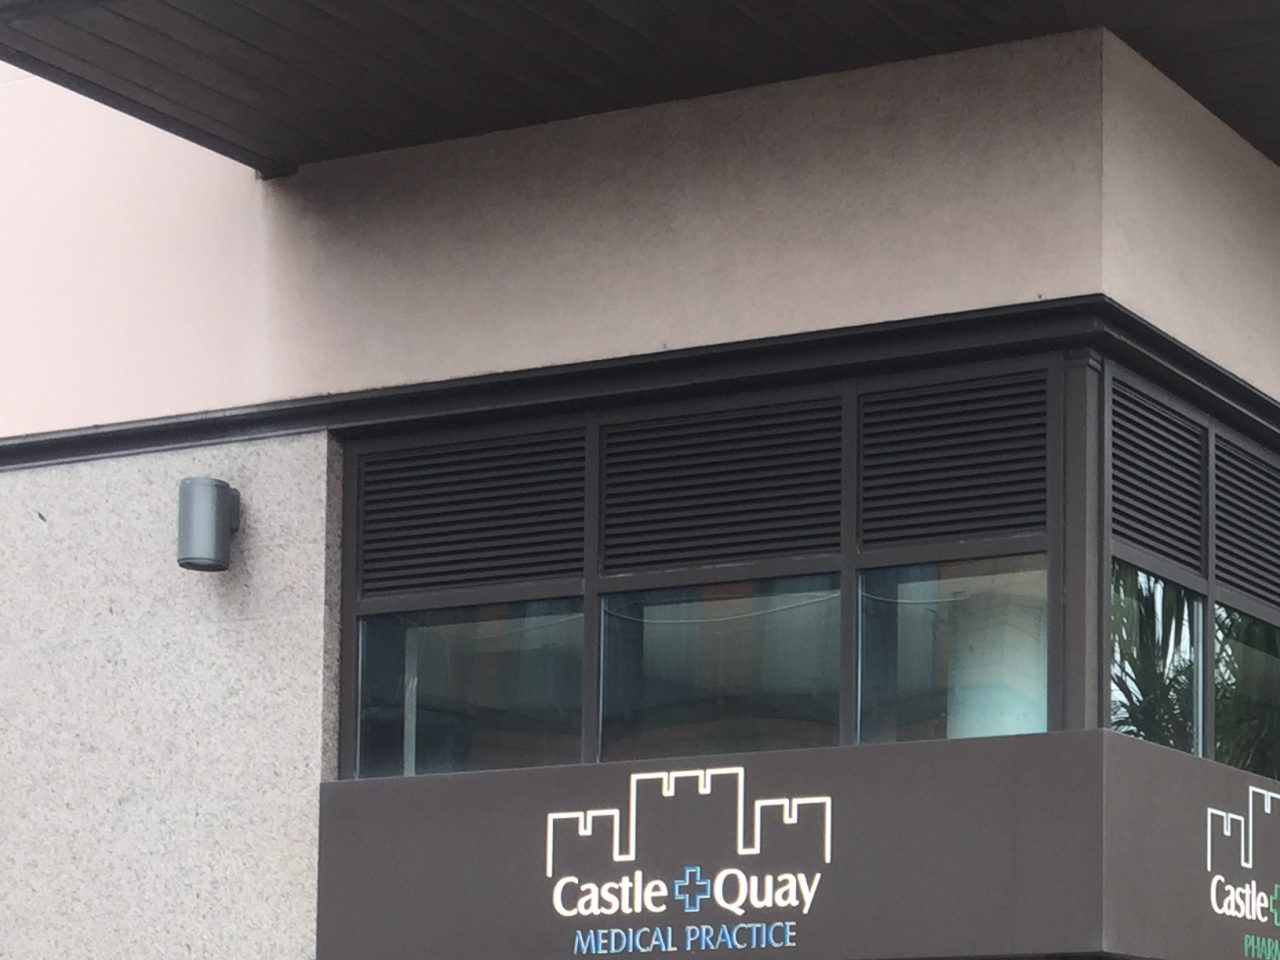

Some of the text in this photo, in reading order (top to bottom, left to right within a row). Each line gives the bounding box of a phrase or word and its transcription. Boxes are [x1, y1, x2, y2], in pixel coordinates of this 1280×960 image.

[552, 868, 822, 917] Castle Quay
[1210, 874, 1269, 923] Castle
[573, 921, 797, 955] MEDICAL PRACTICE
